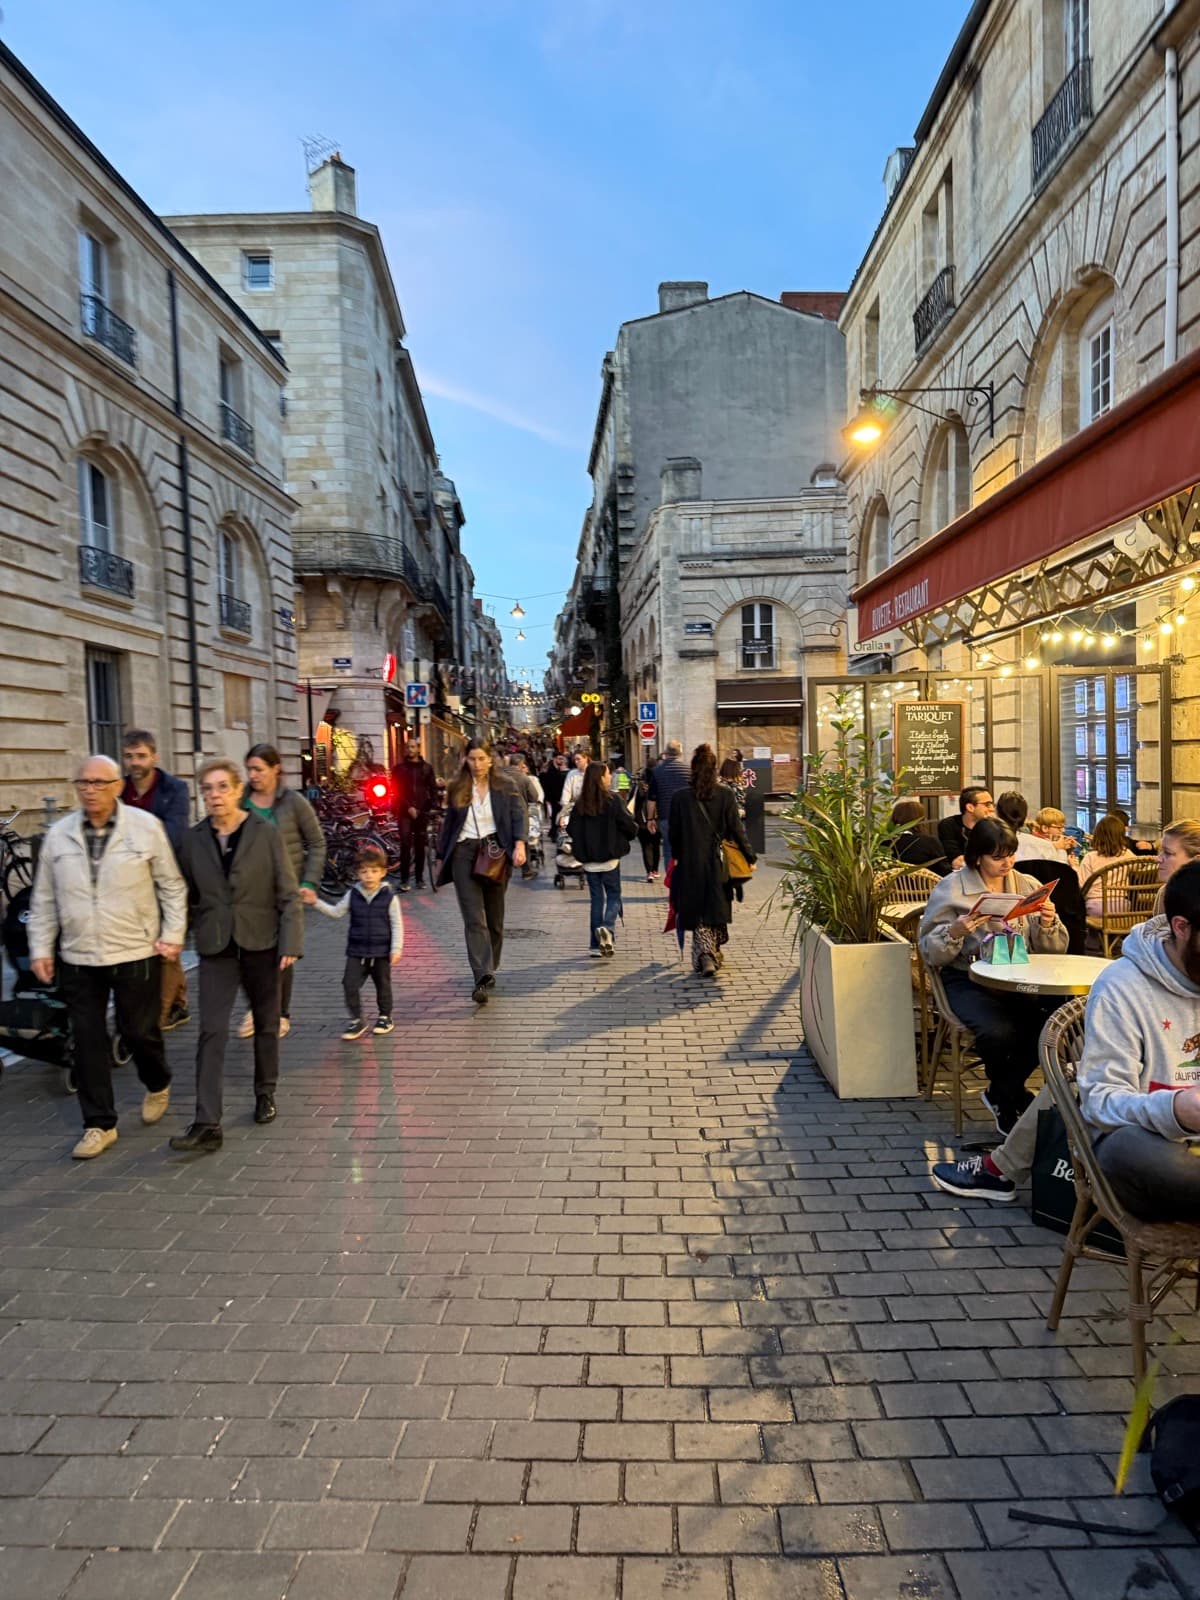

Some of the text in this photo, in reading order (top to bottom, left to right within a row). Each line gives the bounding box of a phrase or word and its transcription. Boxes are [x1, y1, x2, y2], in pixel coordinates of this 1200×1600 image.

[894, 578, 929, 620] RESTAURANT
[905, 711, 954, 725] TARIQUET
[1051, 1158, 1075, 1183] Be
